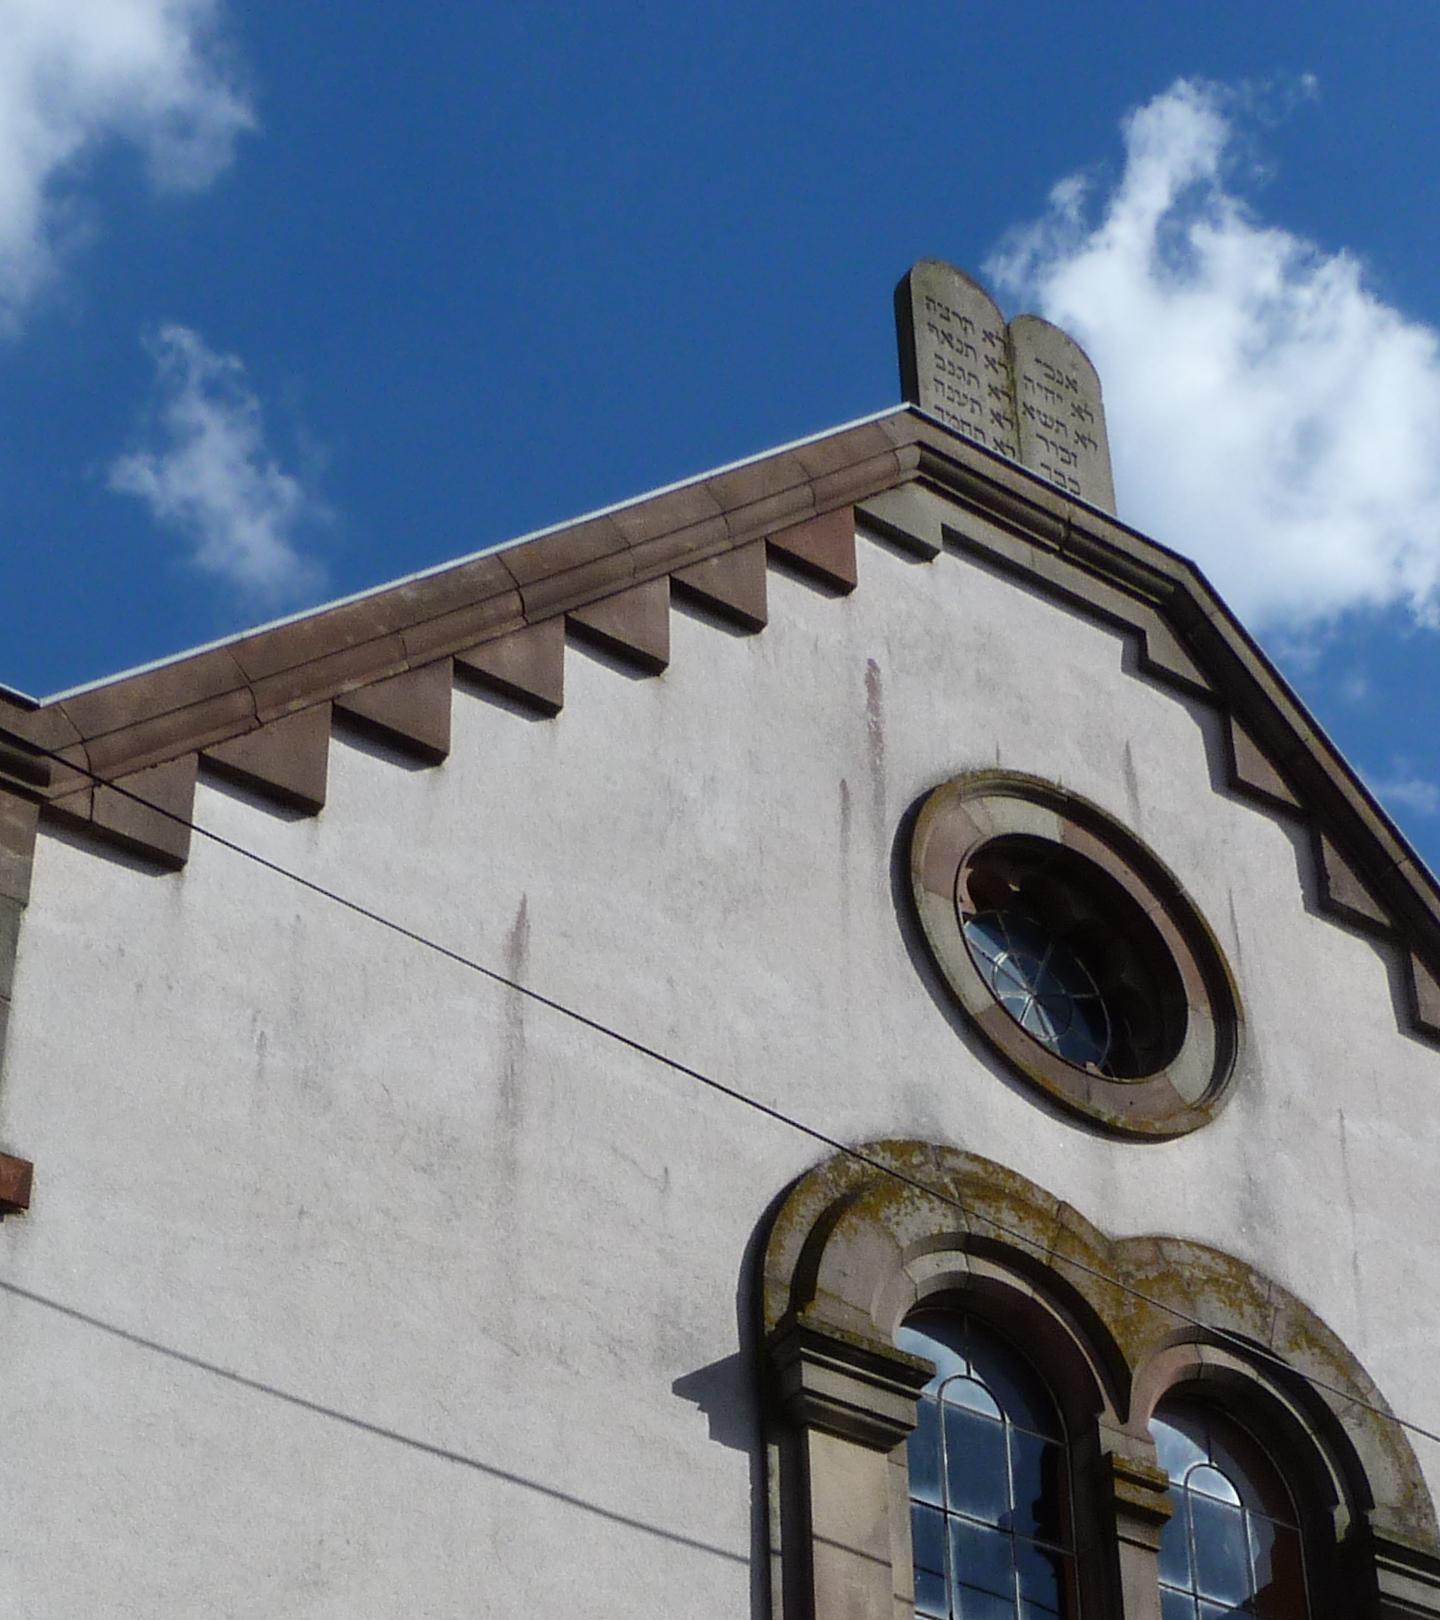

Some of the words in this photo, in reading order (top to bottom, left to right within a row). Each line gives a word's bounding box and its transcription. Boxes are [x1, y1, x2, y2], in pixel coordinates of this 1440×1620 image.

[982, 329, 1007, 352] לא
[984, 354, 1010, 379] לא
[988, 383, 1012, 403] לא
[990, 409, 1014, 430] לא
[1070, 401, 1094, 424] לא
[993, 437, 1016, 458] לא
[1074, 430, 1098, 452] לא
